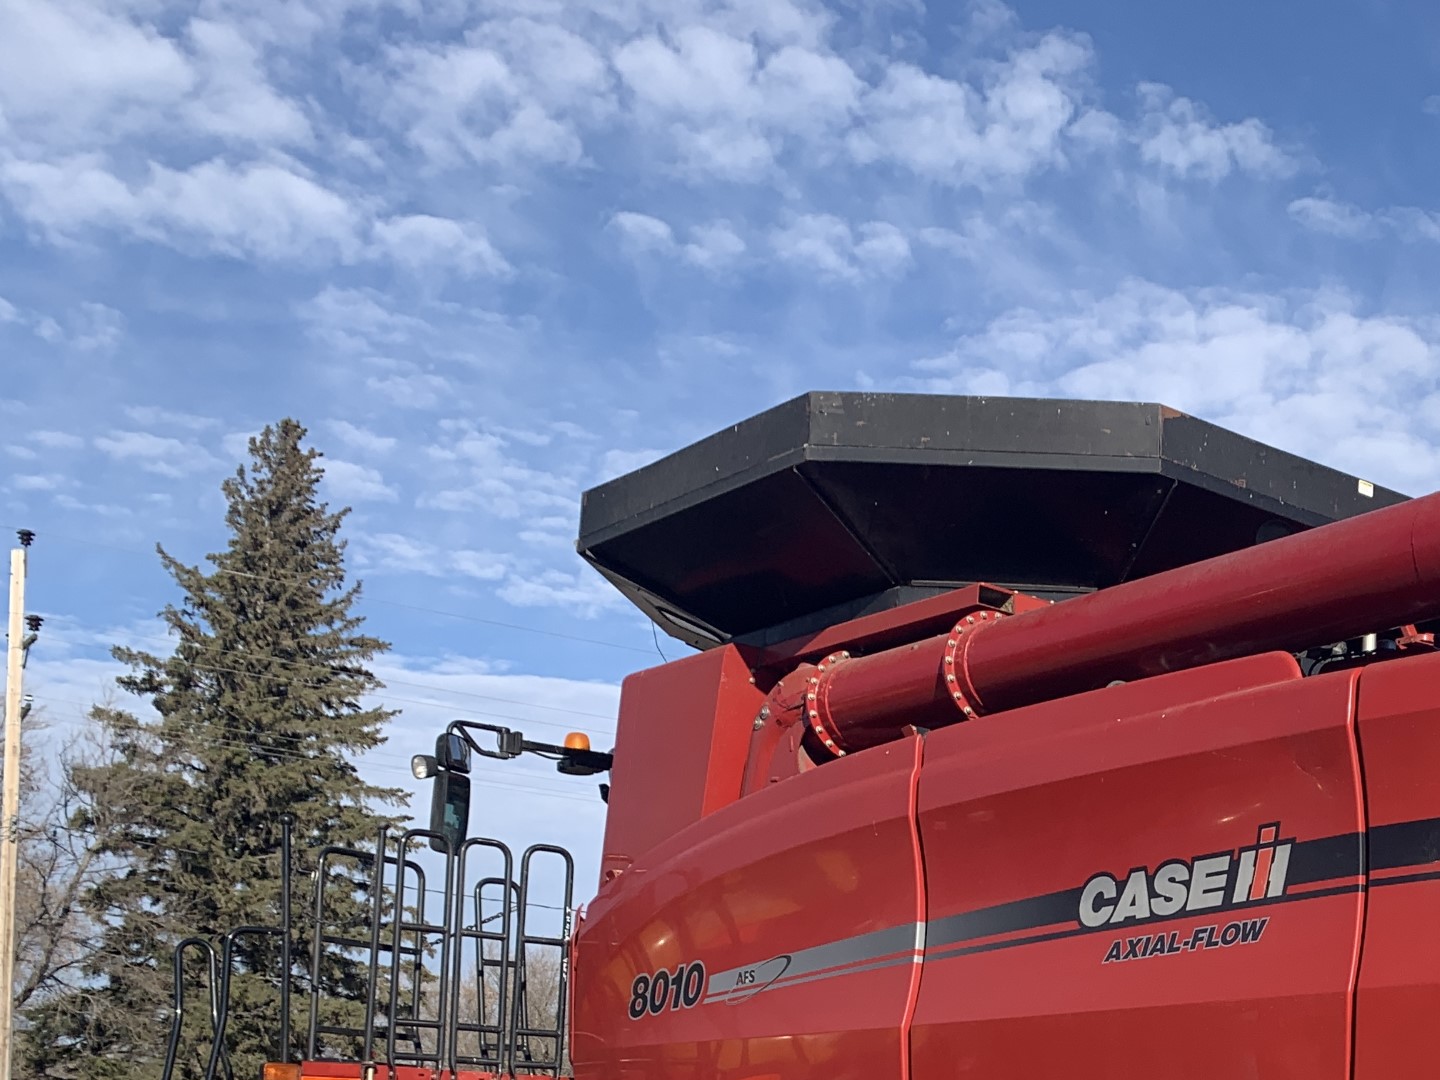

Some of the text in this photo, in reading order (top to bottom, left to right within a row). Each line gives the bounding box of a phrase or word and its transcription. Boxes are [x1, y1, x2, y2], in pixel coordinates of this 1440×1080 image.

[1079, 858, 1231, 930] CASE
[1102, 917, 1268, 964] AXIAL-FLOW
[627, 962, 757, 1020] 8010 AFS
